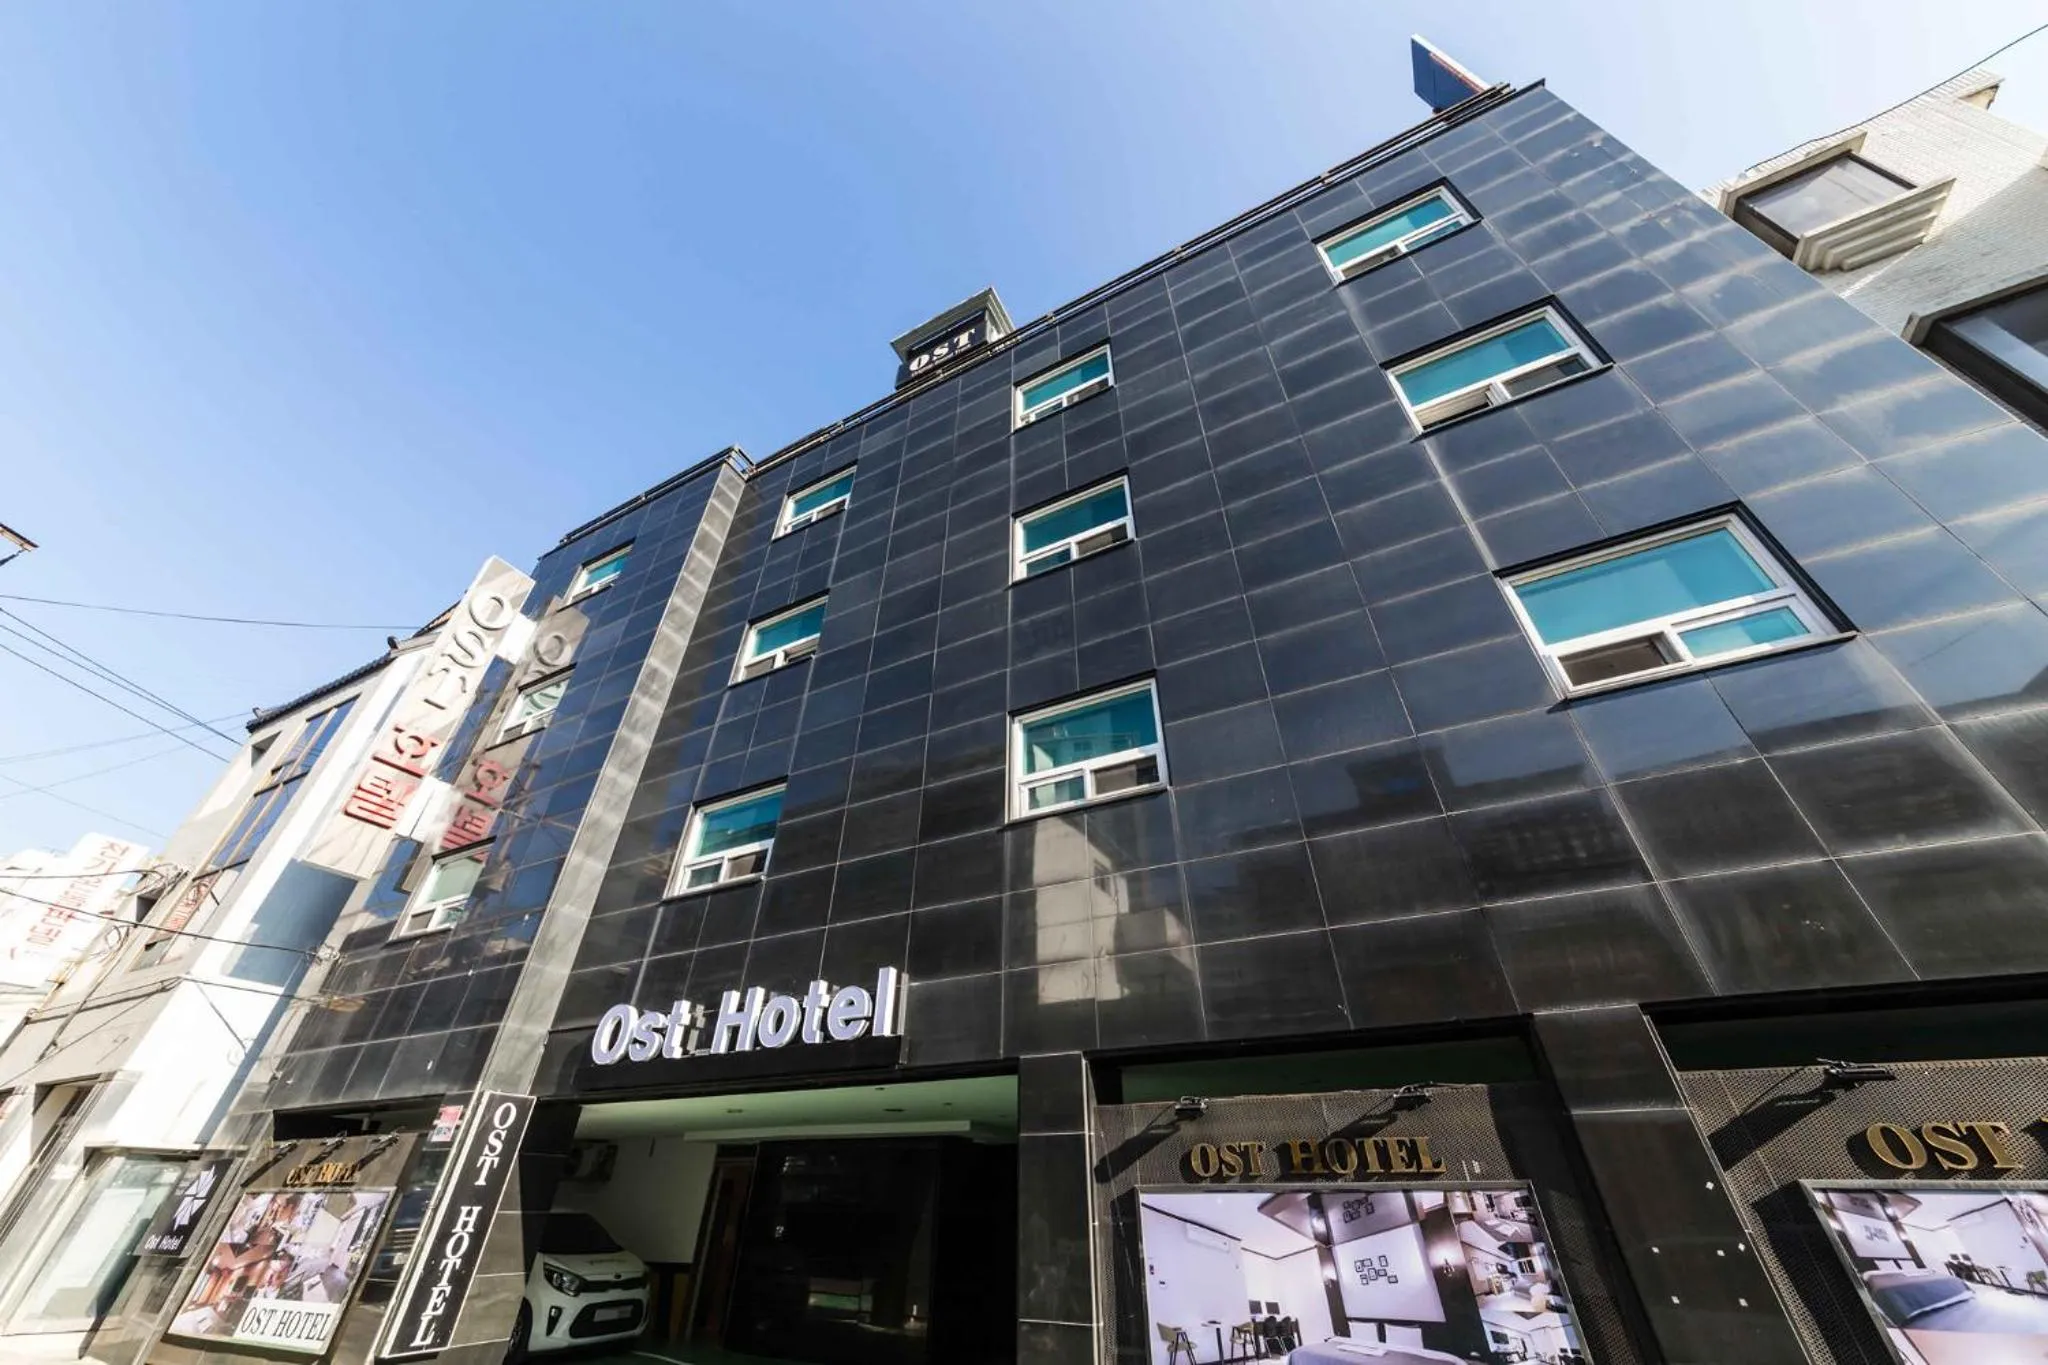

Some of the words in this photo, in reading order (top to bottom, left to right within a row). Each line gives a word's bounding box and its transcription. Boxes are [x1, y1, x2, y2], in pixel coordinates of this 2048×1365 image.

[909, 328, 975, 373] OST
[420, 591, 515, 711] OST
[343, 723, 438, 830] 호텔
[591, 1000, 692, 1066] Ost
[710, 966, 897, 1055] Hotel
[473, 1102, 517, 1186] OST
[1190, 1141, 1267, 1178] OST
[1287, 1136, 1447, 1176] HOTEL
[1866, 1121, 2022, 1171] OST
[409, 1206, 483, 1347] HOTEL
[241, 1307, 277, 1336] OST
[273, 1309, 331, 1342] HOTEL
